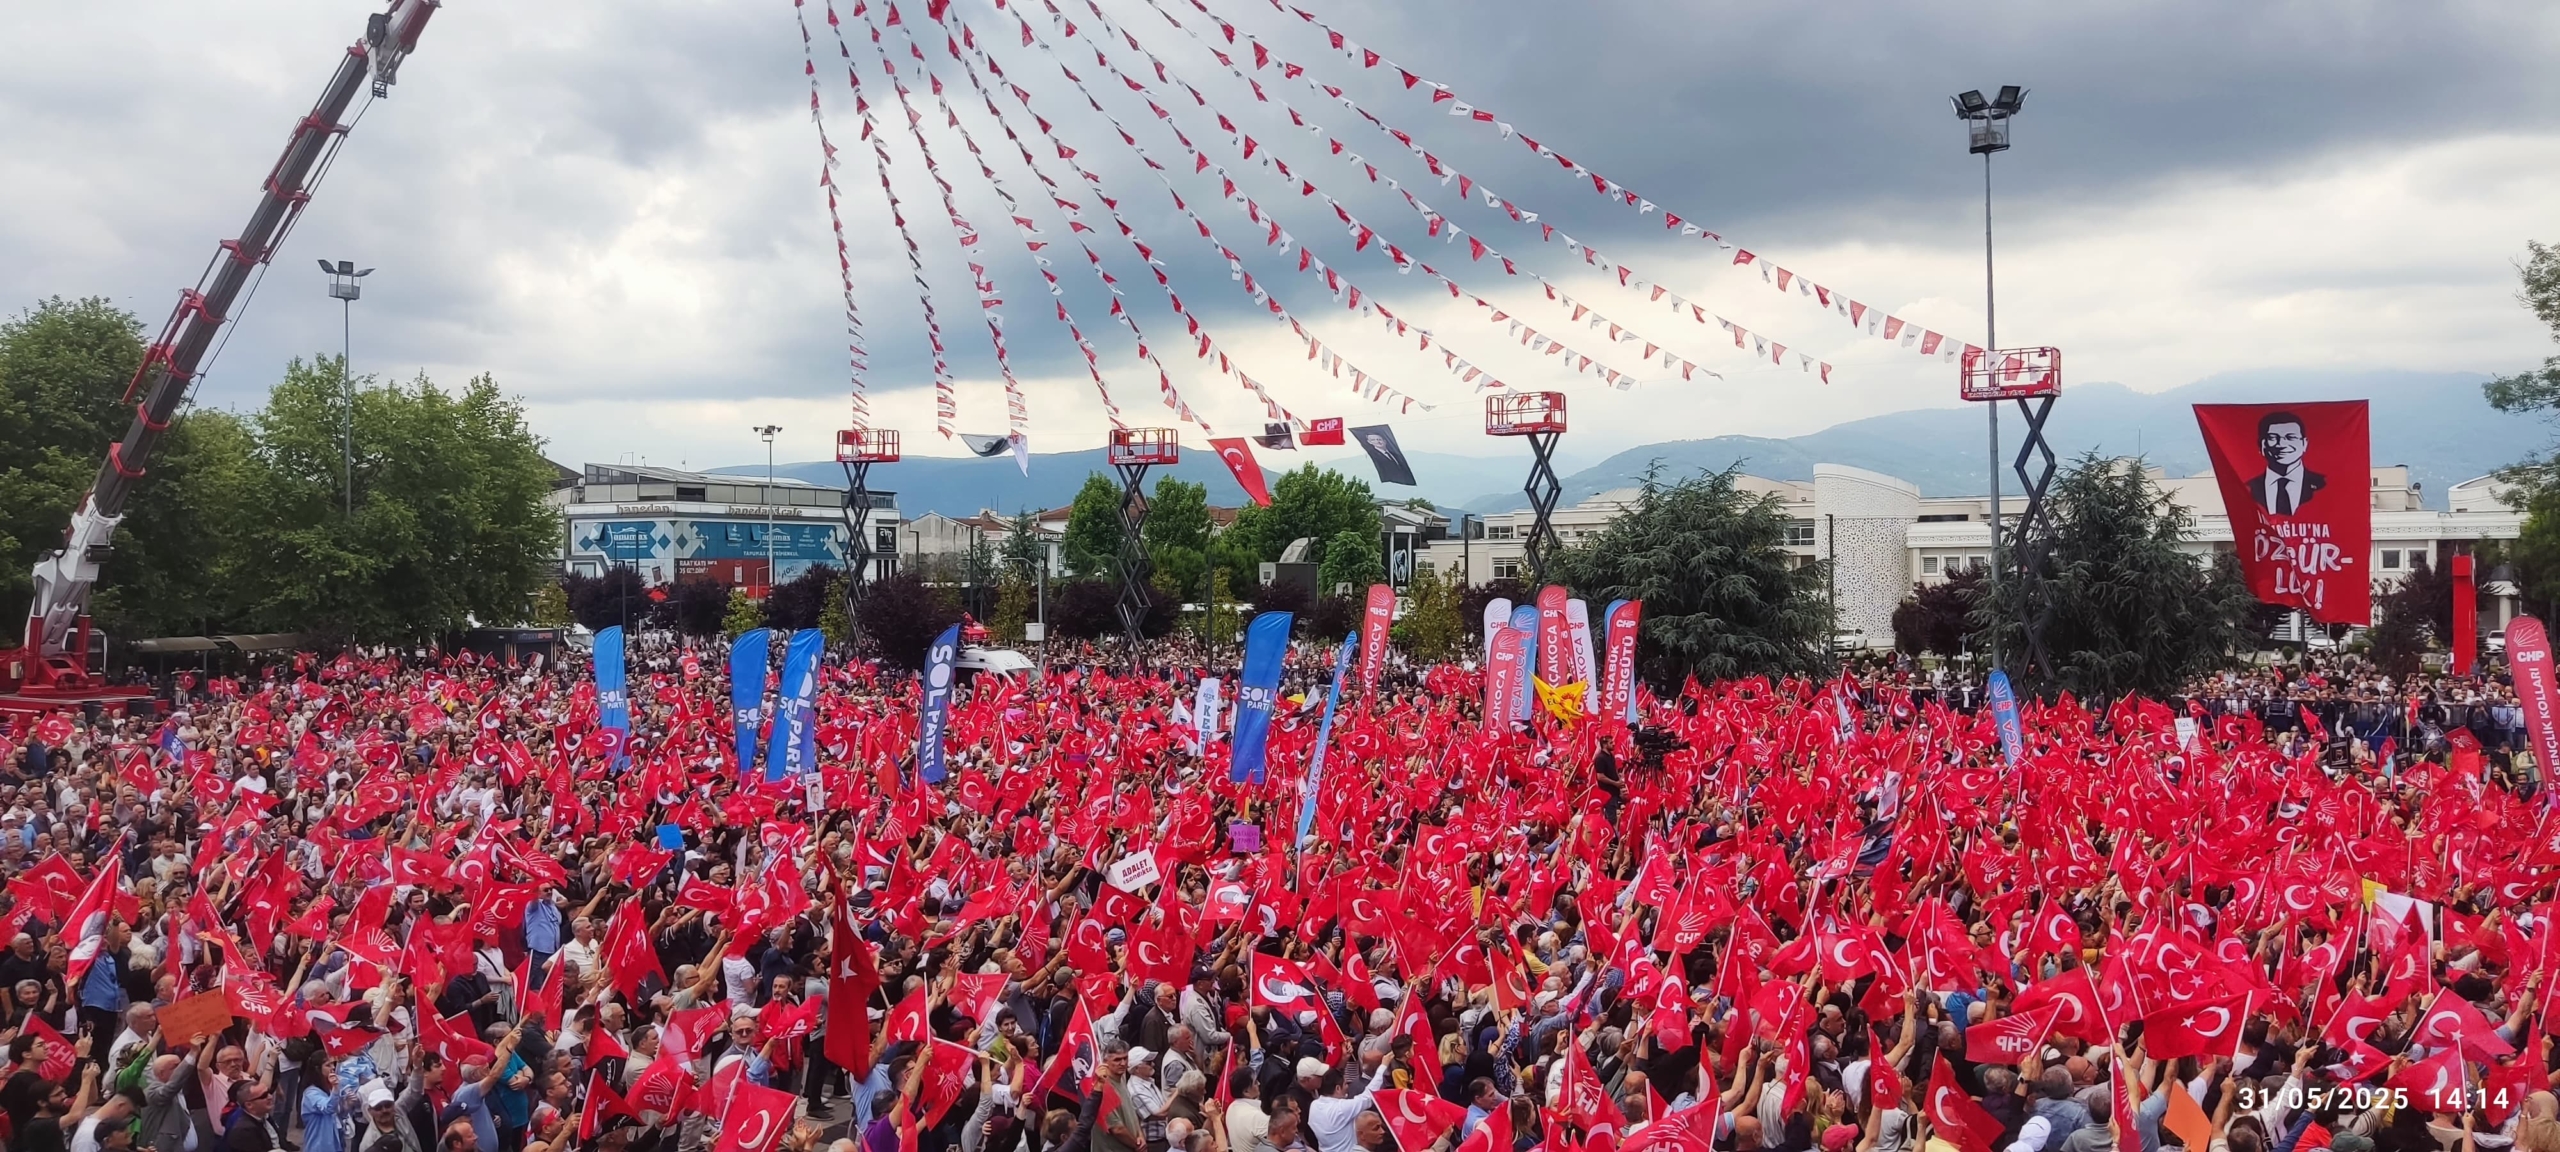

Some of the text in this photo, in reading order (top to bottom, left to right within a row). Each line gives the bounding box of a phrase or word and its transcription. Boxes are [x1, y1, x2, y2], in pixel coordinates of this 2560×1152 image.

[1317, 419, 1338, 432] CHP
[1616, 619, 1636, 629] CHP
[1496, 652, 1514, 661] CHP
[1547, 625, 1562, 690] KÇAKOCA
[2517, 650, 2545, 662] CHP
[929, 644, 952, 706] SOL
[1574, 637, 1590, 703] KÇAKOCA
[1604, 644, 1620, 710] KARABÜK
[1615, 635, 1634, 703] ÖRGÜTÜ
[1511, 647, 1527, 720] KÇAKOCA
[601, 690, 623, 703] SOL
[1241, 687, 1270, 703] SOL
[2529, 668, 2550, 718] KOLLARI
[1613, 707, 1626, 720] İL
[2542, 721, 2560, 775] GENÇLİK
[1122, 859, 1148, 878] ADALET
[473, 922, 496, 936] CHP
[241, 1000, 272, 1015] CHP
[2271, 992, 2296, 1007] CH
